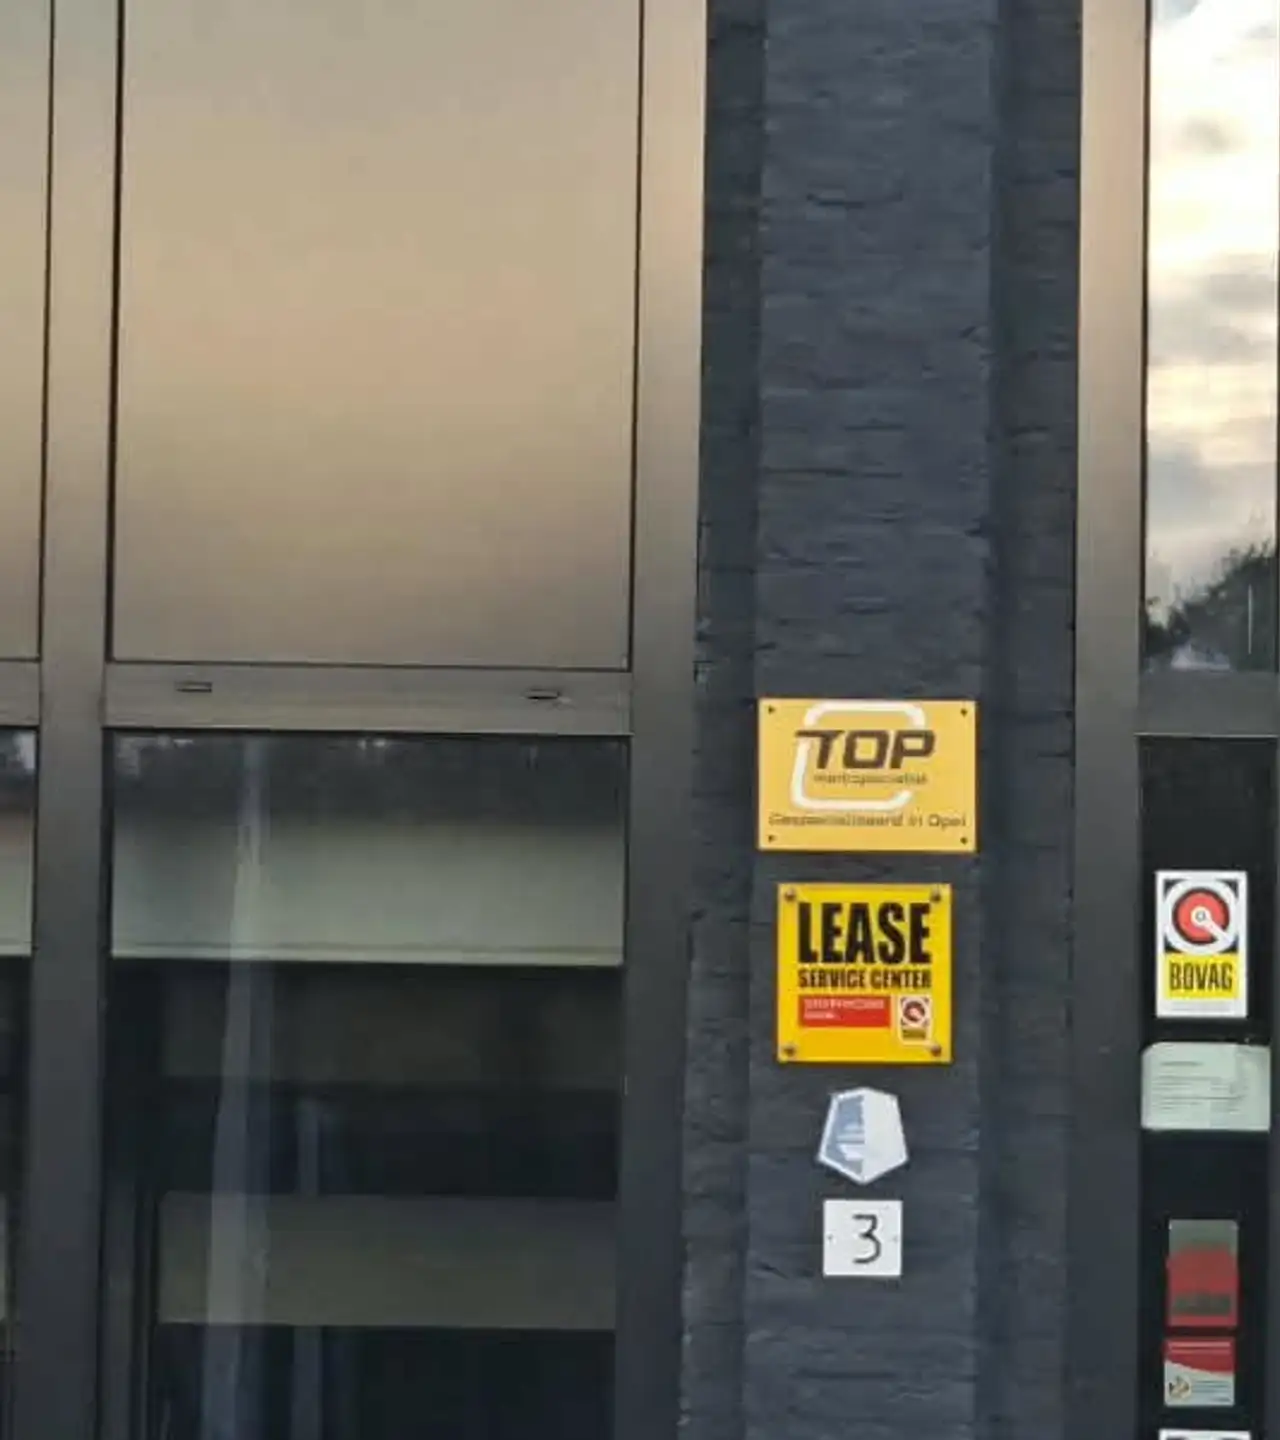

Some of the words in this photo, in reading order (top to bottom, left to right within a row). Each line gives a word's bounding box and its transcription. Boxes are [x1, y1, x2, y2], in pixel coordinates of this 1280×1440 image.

[794, 729, 936, 770] TOP
[928, 813, 967, 831] Opel
[798, 901, 932, 965] LEASE
[798, 968, 866, 989] SERVICE
[868, 969, 933, 990] CENTER
[1168, 960, 1234, 992] BOVAG
[852, 1213, 882, 1265] 3
